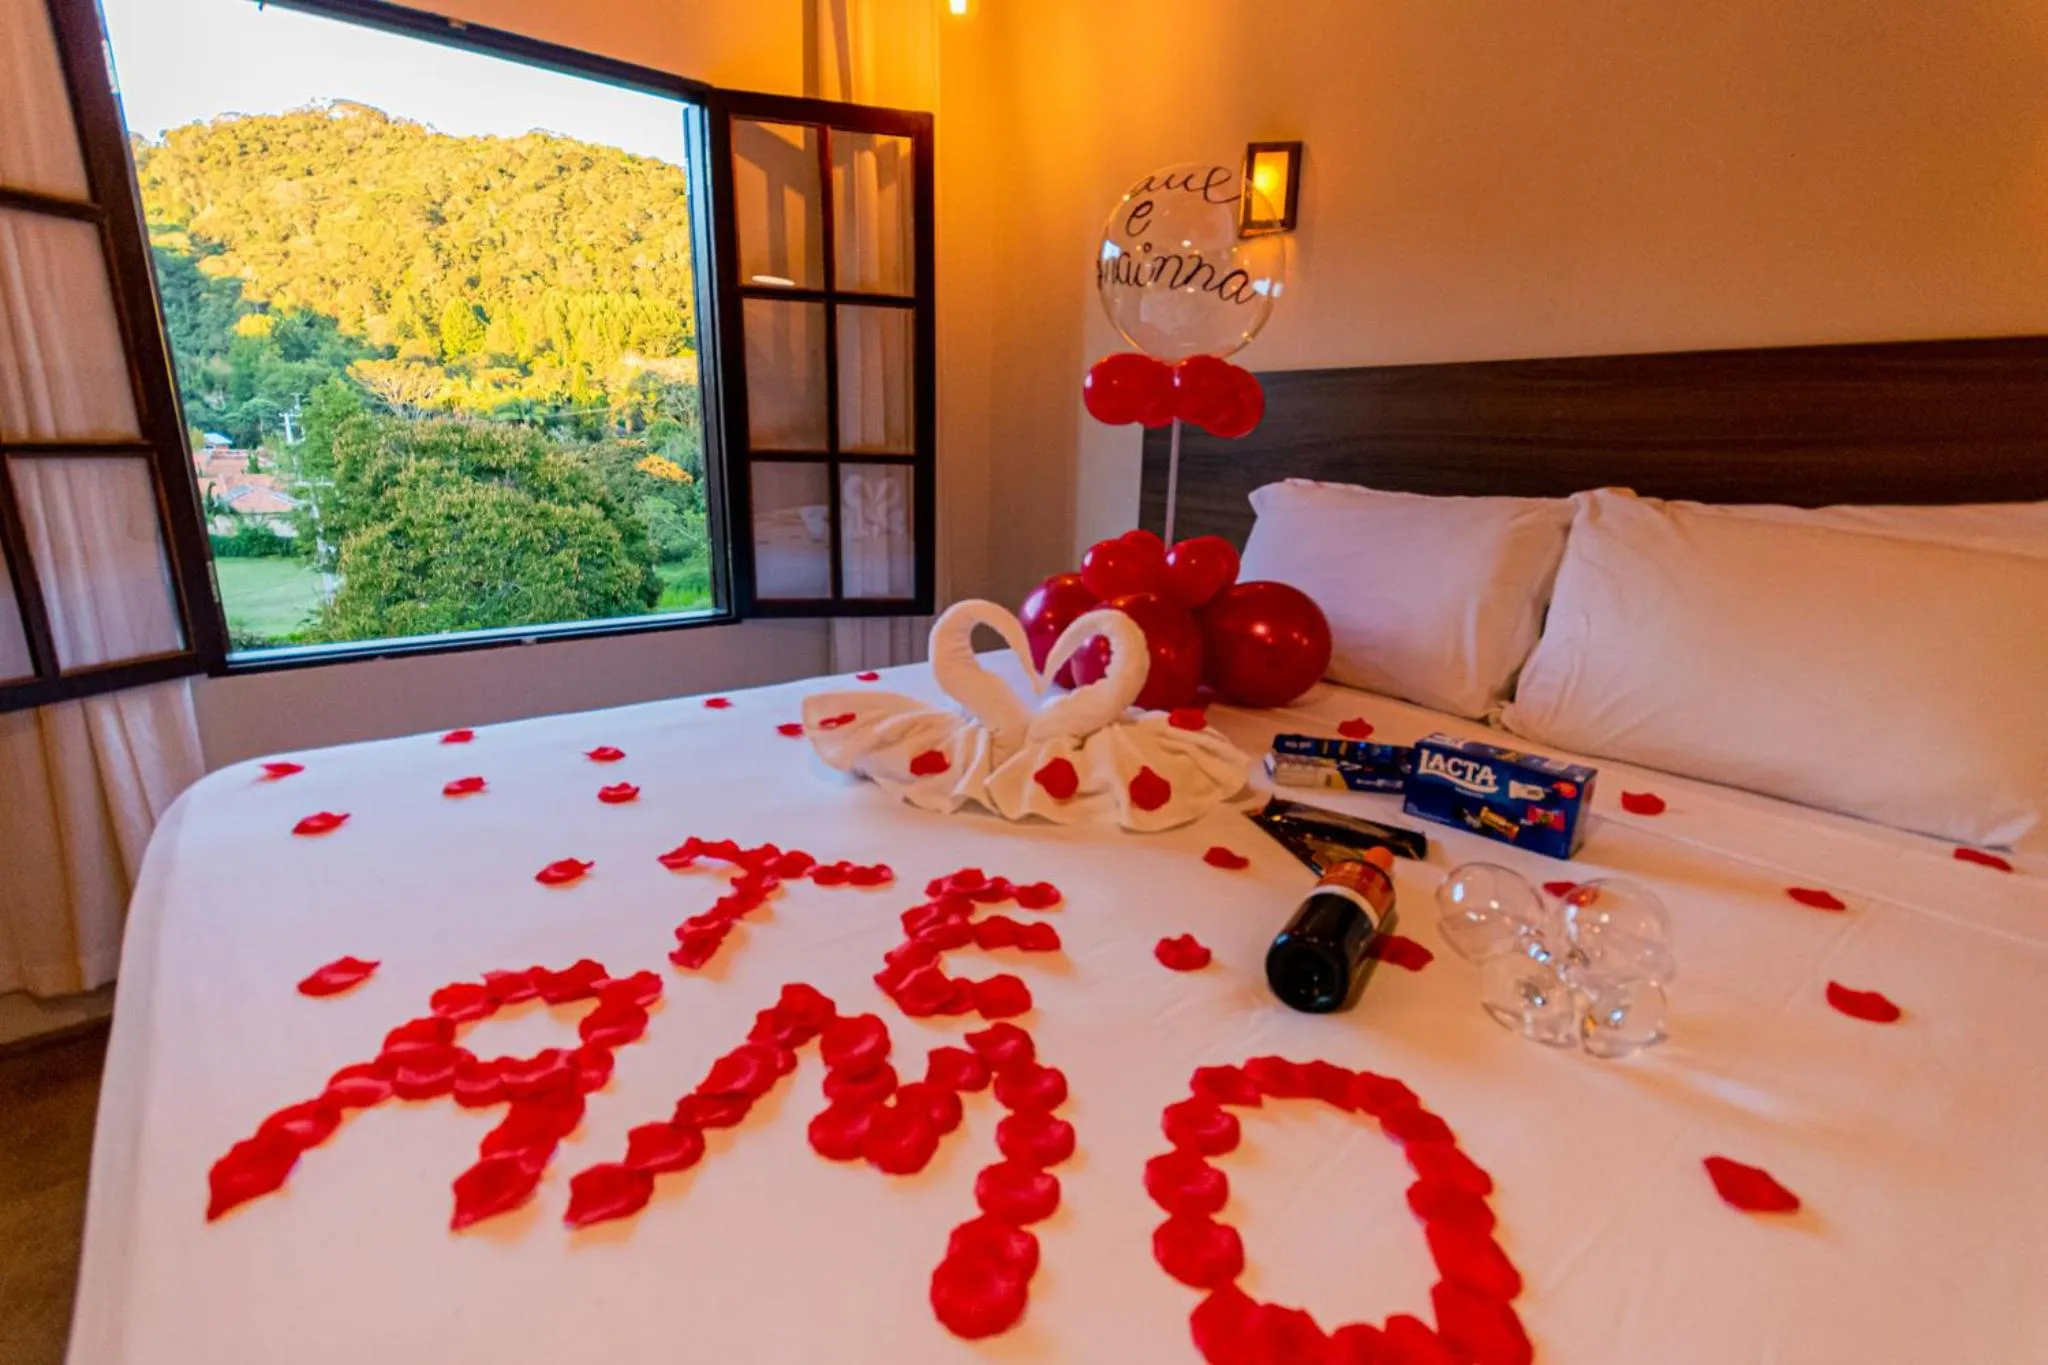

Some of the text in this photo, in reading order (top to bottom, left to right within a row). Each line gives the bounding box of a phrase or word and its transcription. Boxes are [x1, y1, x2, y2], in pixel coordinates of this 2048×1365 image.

[1417, 747, 1500, 787] LACTA
[658, 836, 1062, 1019] TE
[206, 958, 1533, 1365] AMO
